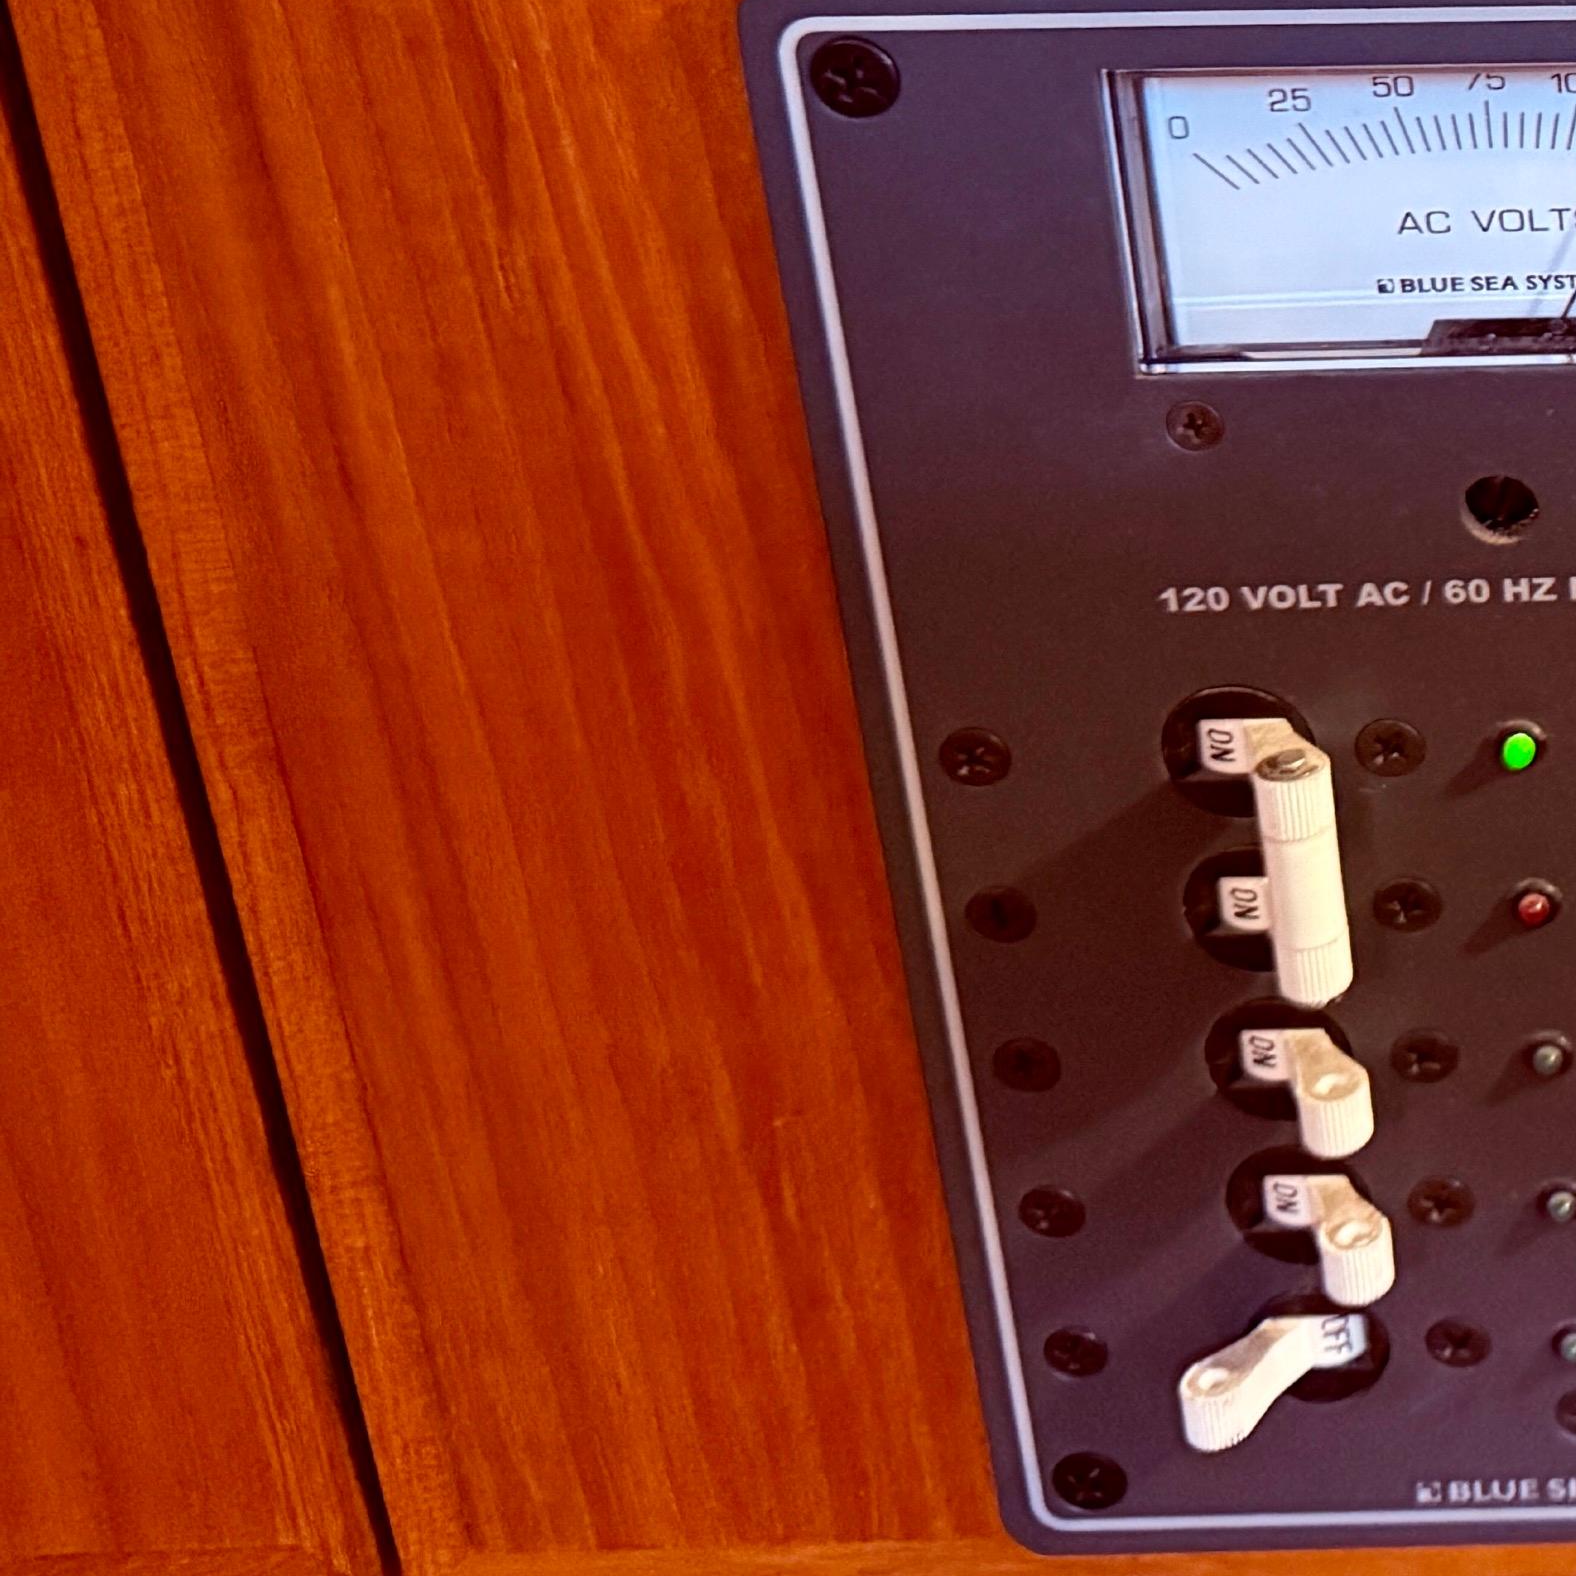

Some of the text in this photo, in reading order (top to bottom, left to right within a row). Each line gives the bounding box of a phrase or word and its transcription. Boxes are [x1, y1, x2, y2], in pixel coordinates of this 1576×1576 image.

[1370, 75, 1417, 97] 50
[1268, 87, 1311, 113] 25
[1167, 115, 1190, 140] 0
[1397, 210, 1451, 235] AC
[1399, 276, 1464, 294] BLUE
[1470, 275, 1519, 292] SEA
[1159, 586, 1230, 612] 120
[1240, 583, 1344, 610] VOLT
[1356, 581, 1410, 607] AC
[1444, 578, 1490, 604] 60
[1503, 577, 1558, 603] HZ
[1207, 728, 1236, 762] ON
[1230, 887, 1259, 920] ON
[1249, 1035, 1276, 1069] ON
[1273, 1182, 1299, 1214] ON
[1448, 1479, 1536, 1502] BLUE
